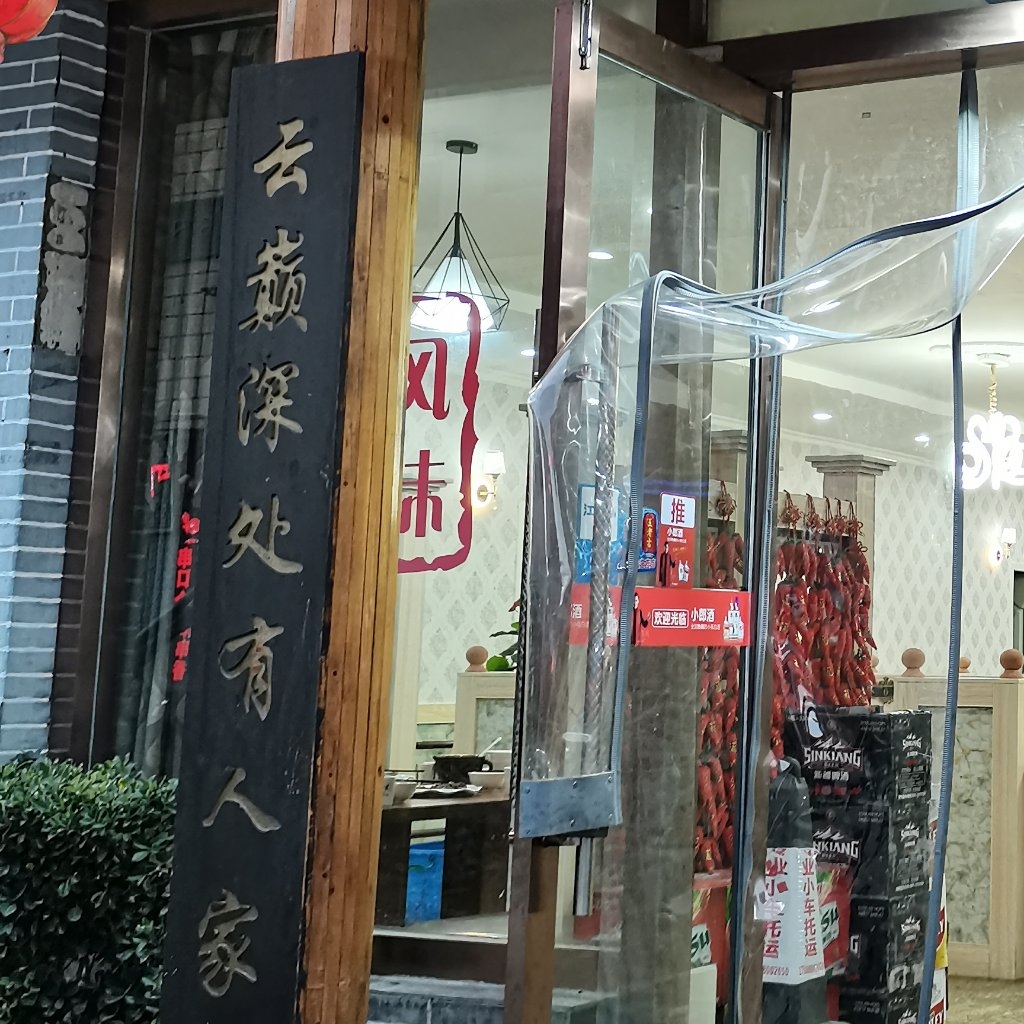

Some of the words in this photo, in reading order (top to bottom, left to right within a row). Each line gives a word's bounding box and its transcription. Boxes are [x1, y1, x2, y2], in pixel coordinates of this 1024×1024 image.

[671, 498, 686, 525] 推
[654, 610, 687, 626] 欢迎光临
[691, 607, 716, 623] 小郎酒
[803, 747, 862, 768] SINKIANG
[813, 839, 860, 859] NKIANG
